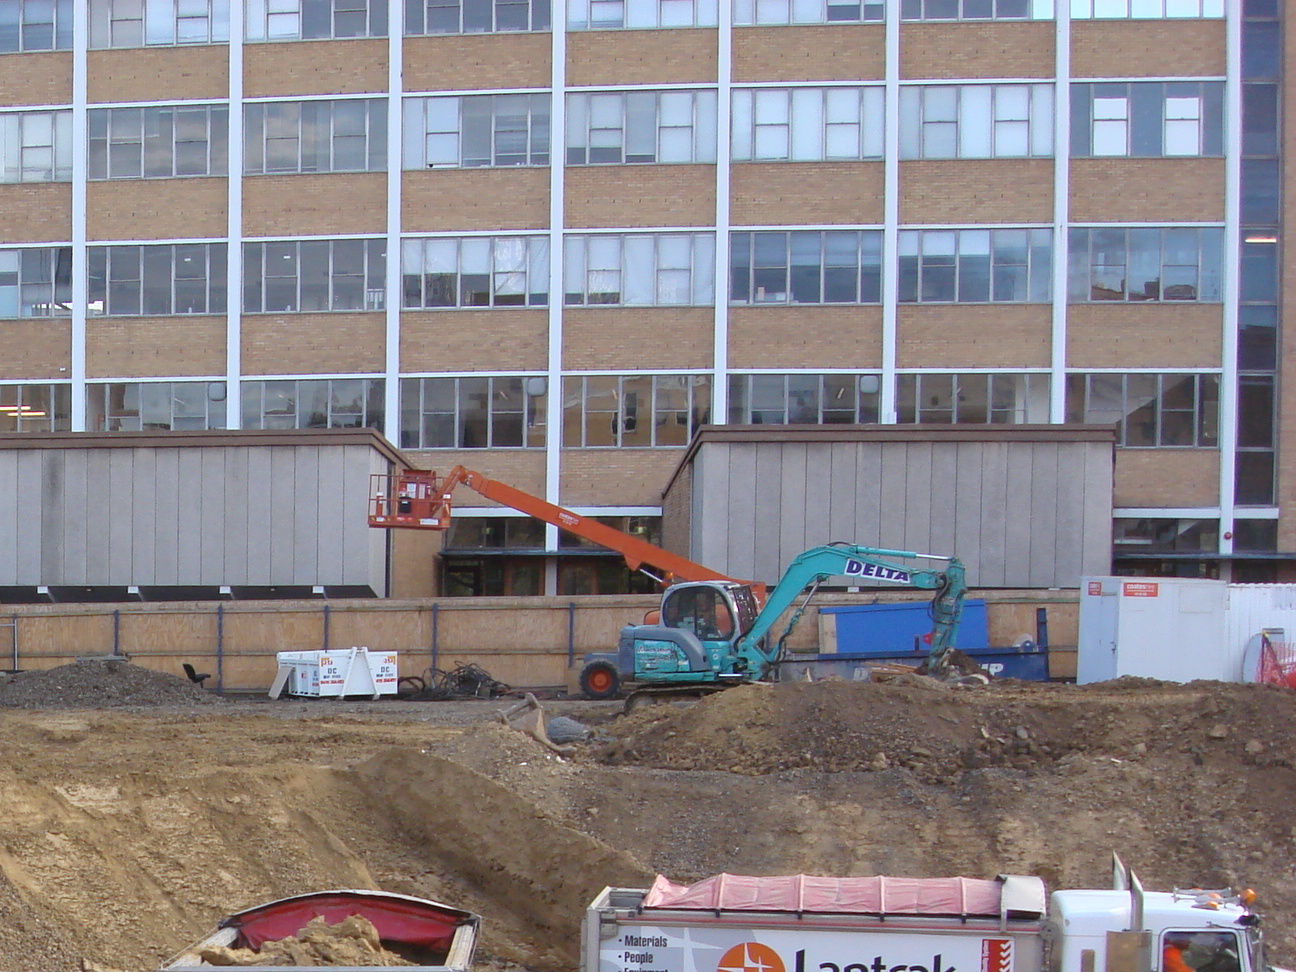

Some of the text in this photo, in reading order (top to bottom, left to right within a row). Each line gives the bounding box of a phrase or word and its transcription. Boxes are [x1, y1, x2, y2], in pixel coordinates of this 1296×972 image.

[845, 559, 910, 582] DELTA
[624, 934, 668, 948] Materials
[624, 951, 654, 965] People
